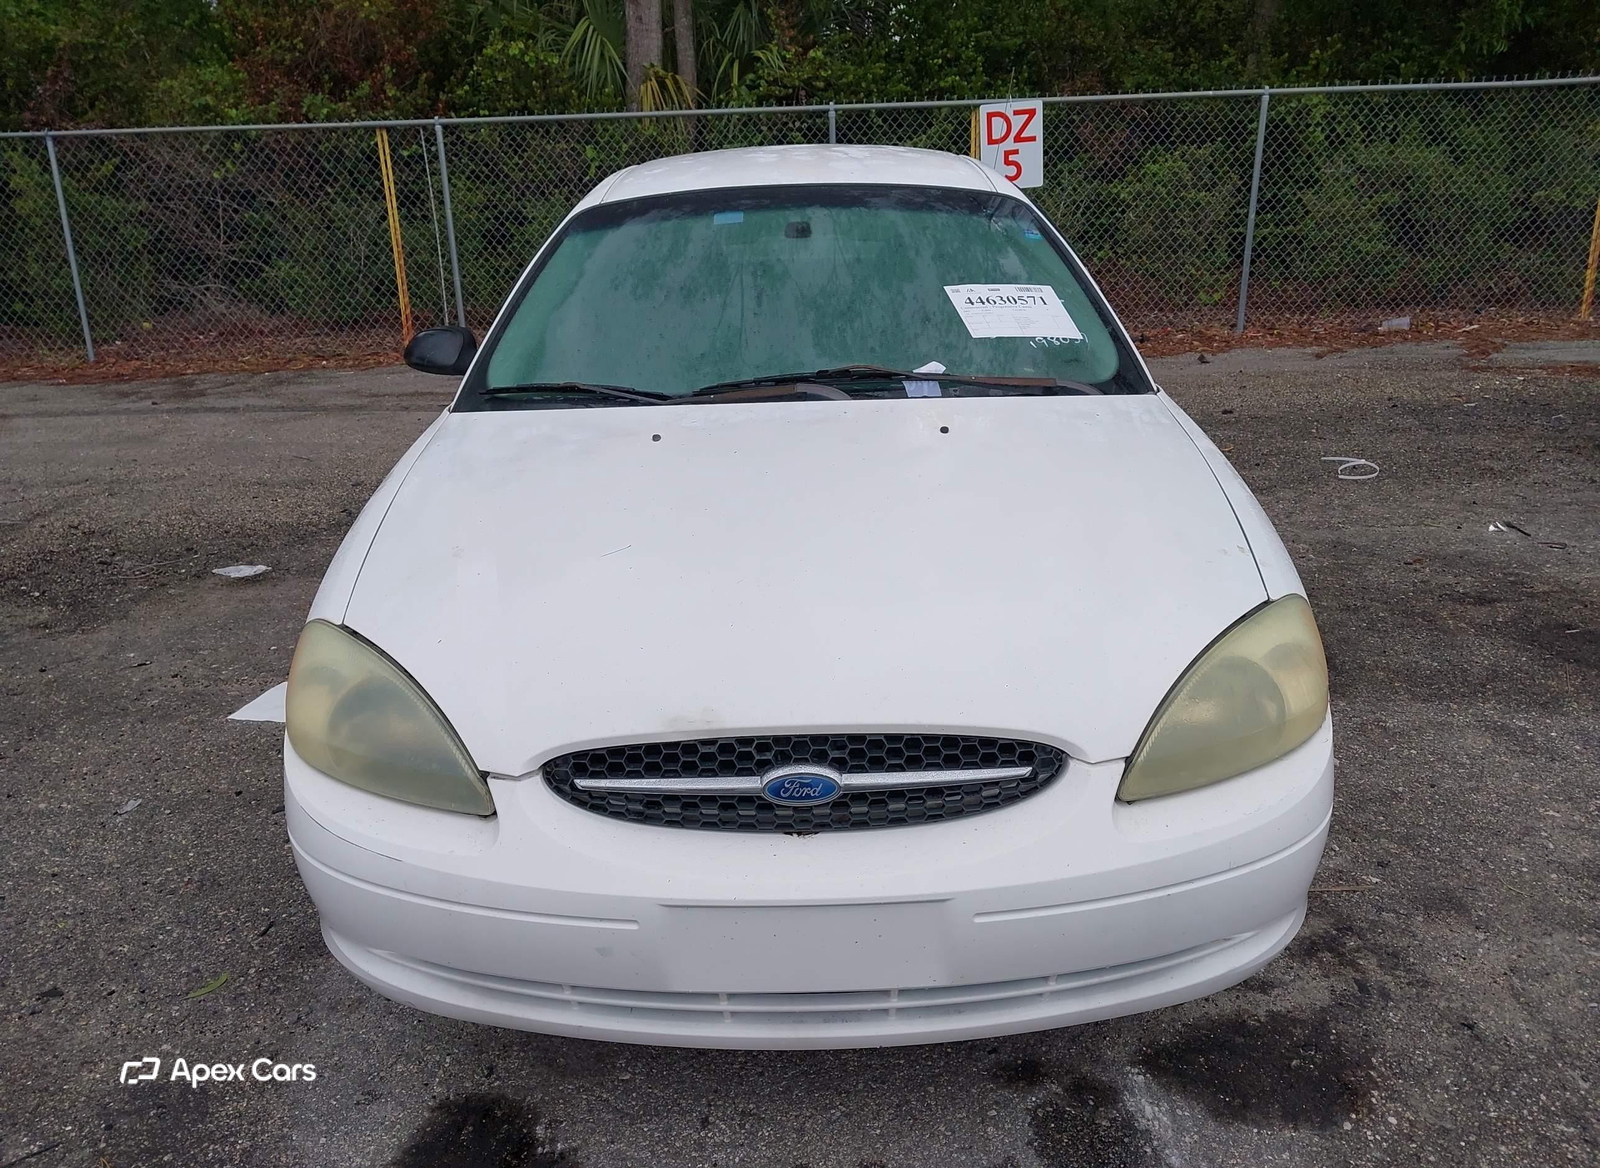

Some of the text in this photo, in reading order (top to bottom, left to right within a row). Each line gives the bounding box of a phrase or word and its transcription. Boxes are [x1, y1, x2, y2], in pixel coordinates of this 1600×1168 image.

[986, 108, 1037, 145] DZ
[1003, 149, 1022, 182] 5
[964, 295, 1048, 306] 44630571
[780, 779, 823, 798] Ford
